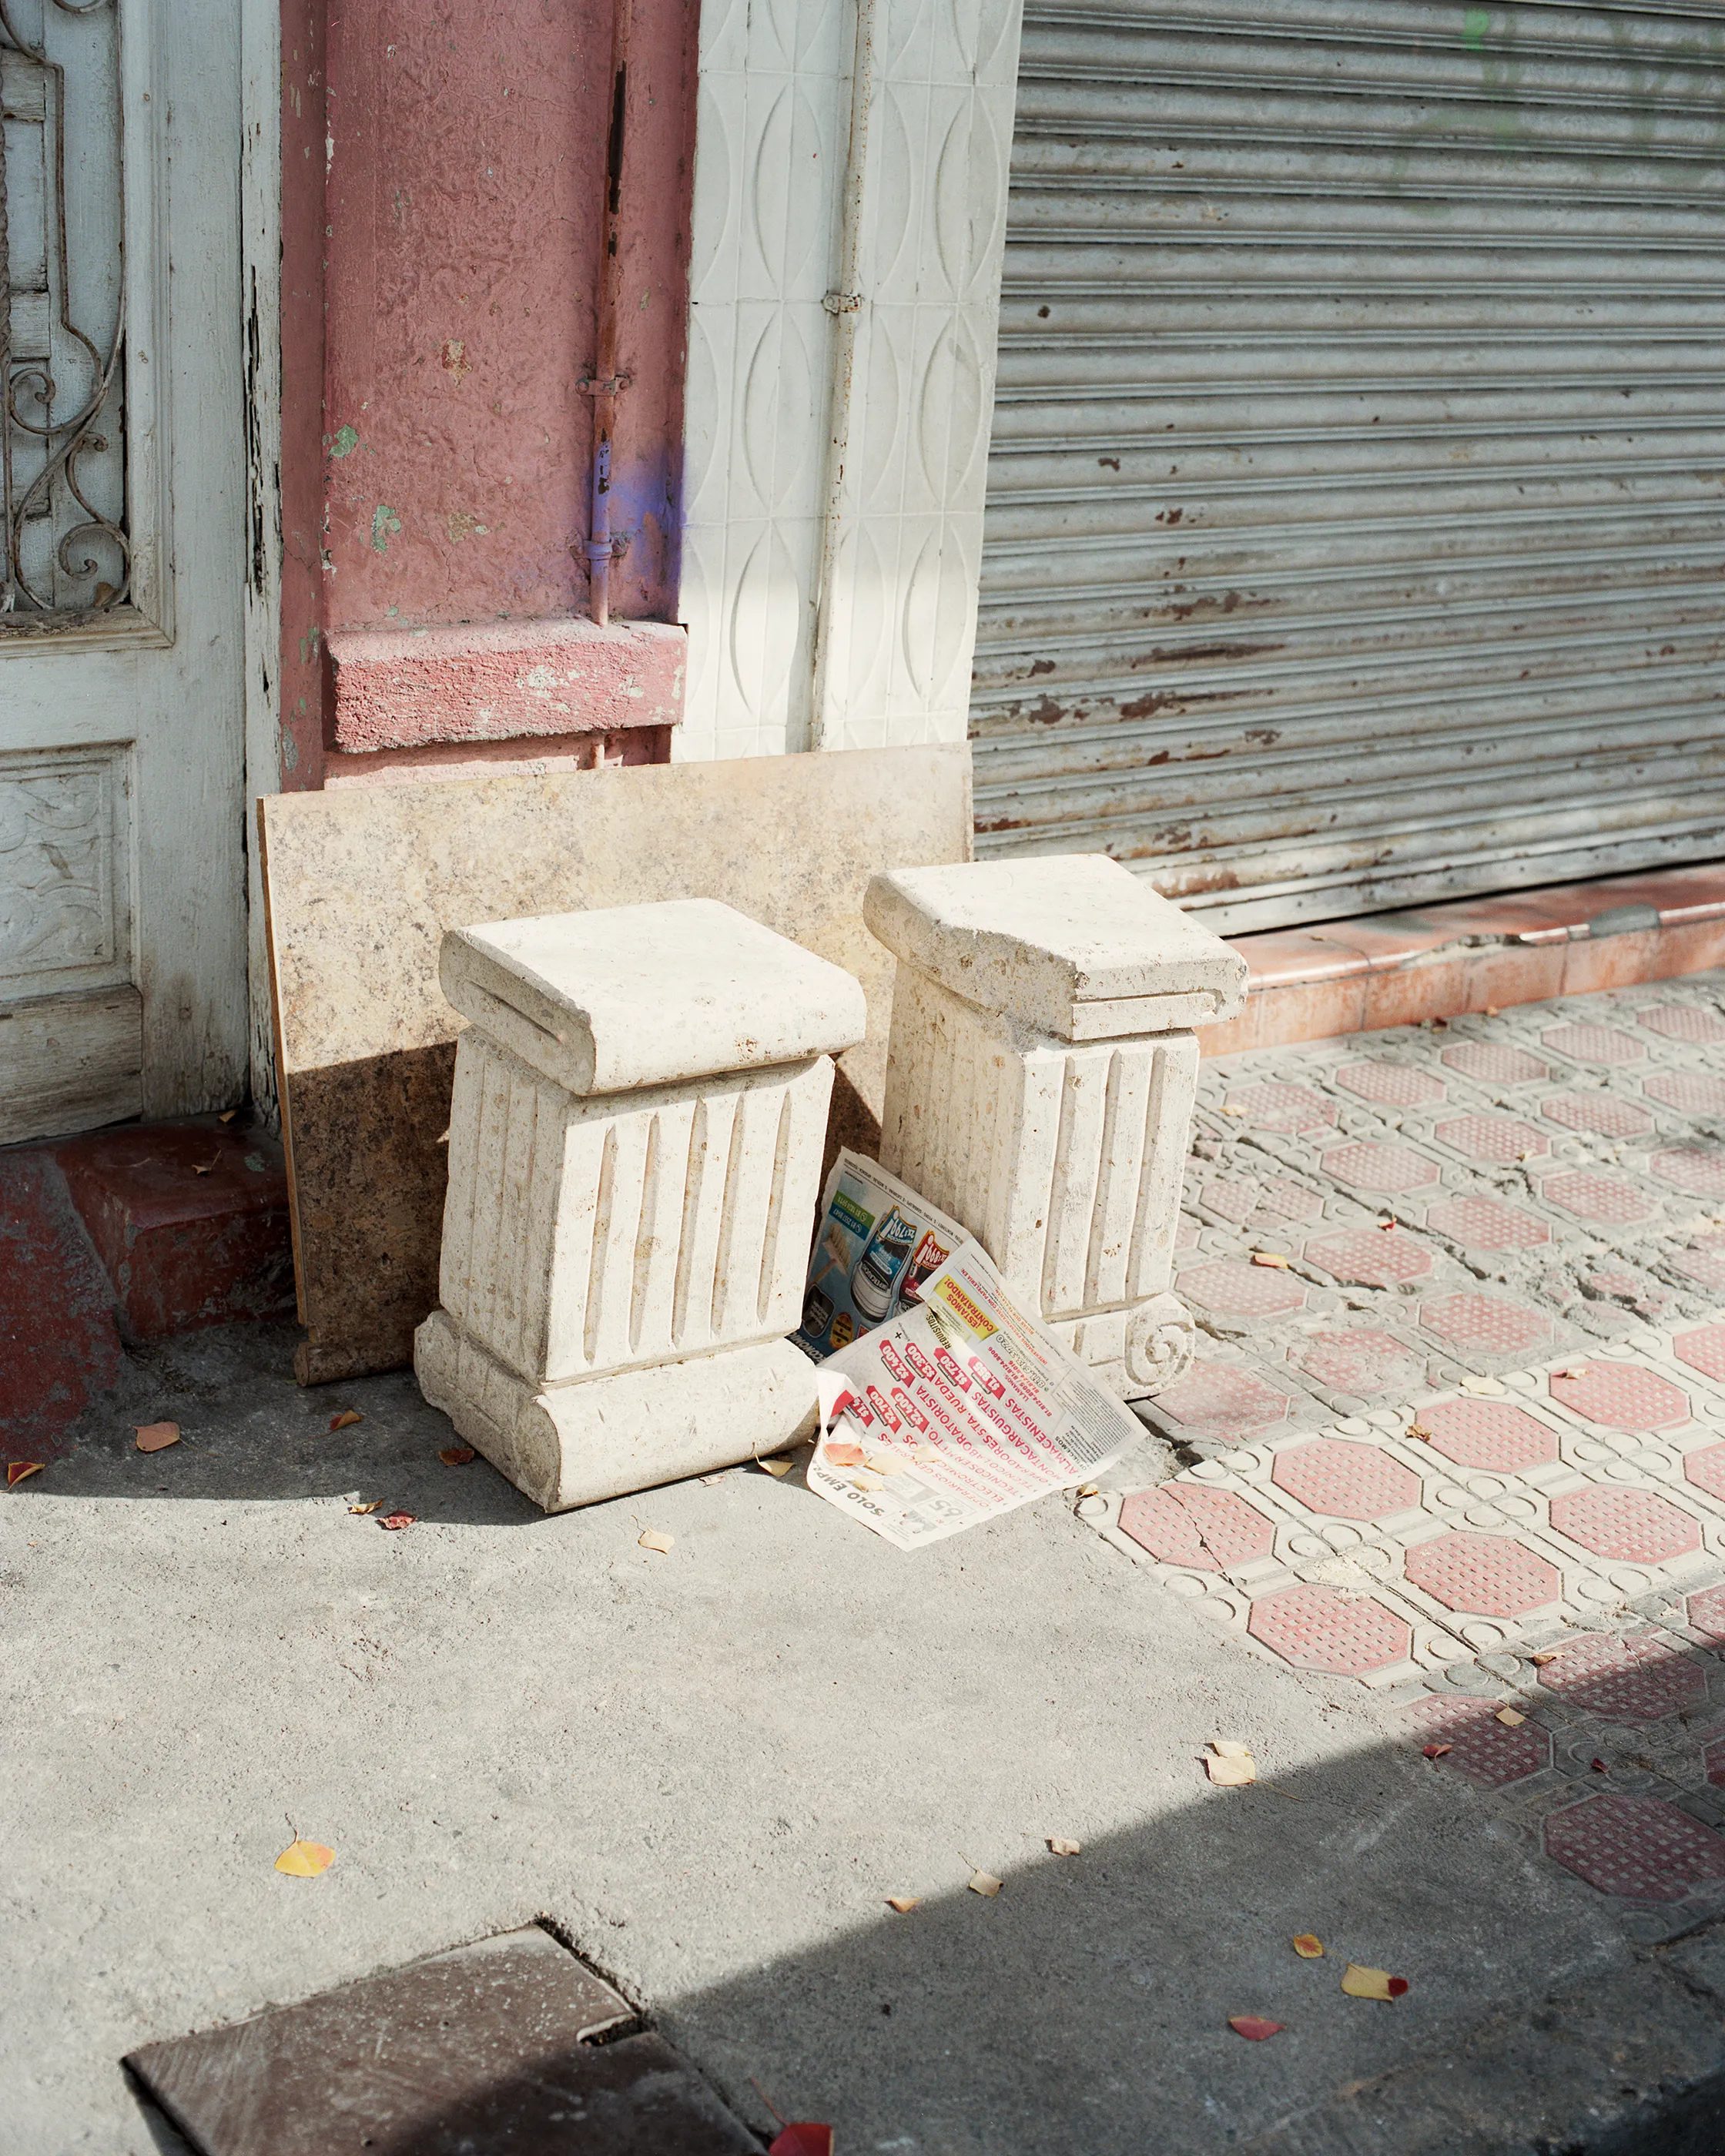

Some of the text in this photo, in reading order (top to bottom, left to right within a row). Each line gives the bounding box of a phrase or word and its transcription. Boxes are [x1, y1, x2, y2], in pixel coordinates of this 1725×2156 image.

[960, 1267, 968, 1277] EN:
[943, 1278, 994, 1331] CONTRATANDO!
[946, 1292, 981, 1328] ¡ESTAMOS
[986, 1298, 997, 1308] CON
[1012, 1312, 1022, 1322] QUE
[925, 1312, 952, 1350] REQUISITOS:
[1020, 1321, 1034, 1334] RUTAS
[881, 1344, 909, 1380] $2,400
[906, 1344, 936, 1378] $3,300
[1020, 1337, 1048, 1365] INTERESADOS
[939, 1354, 968, 1385] $1,730
[972, 1360, 1000, 1391] $1,855
[868, 1390, 896, 1424] $2,700
[893, 1391, 923, 1425] $2,400
[933, 1375, 967, 1414] RUEDA
[914, 1384, 990, 1464] LABORATORISTA
[966, 1411, 986, 1437] 5TA.
[970, 1390, 1063, 1480] MONTACARGUISTAS
[1003, 1397, 1078, 1474] ALMACENISTAS
[901, 1433, 1004, 1502] ELECTROMECOS
[954, 1455, 971, 1466] EN
[980, 1433, 1048, 1484] OPERADORES
[1053, 1435, 1087, 1471] OFRECEMOS
[846, 1494, 885, 1515] SOLO
[932, 1471, 990, 1508] OPERARIOS
[927, 1499, 963, 1517] 65
